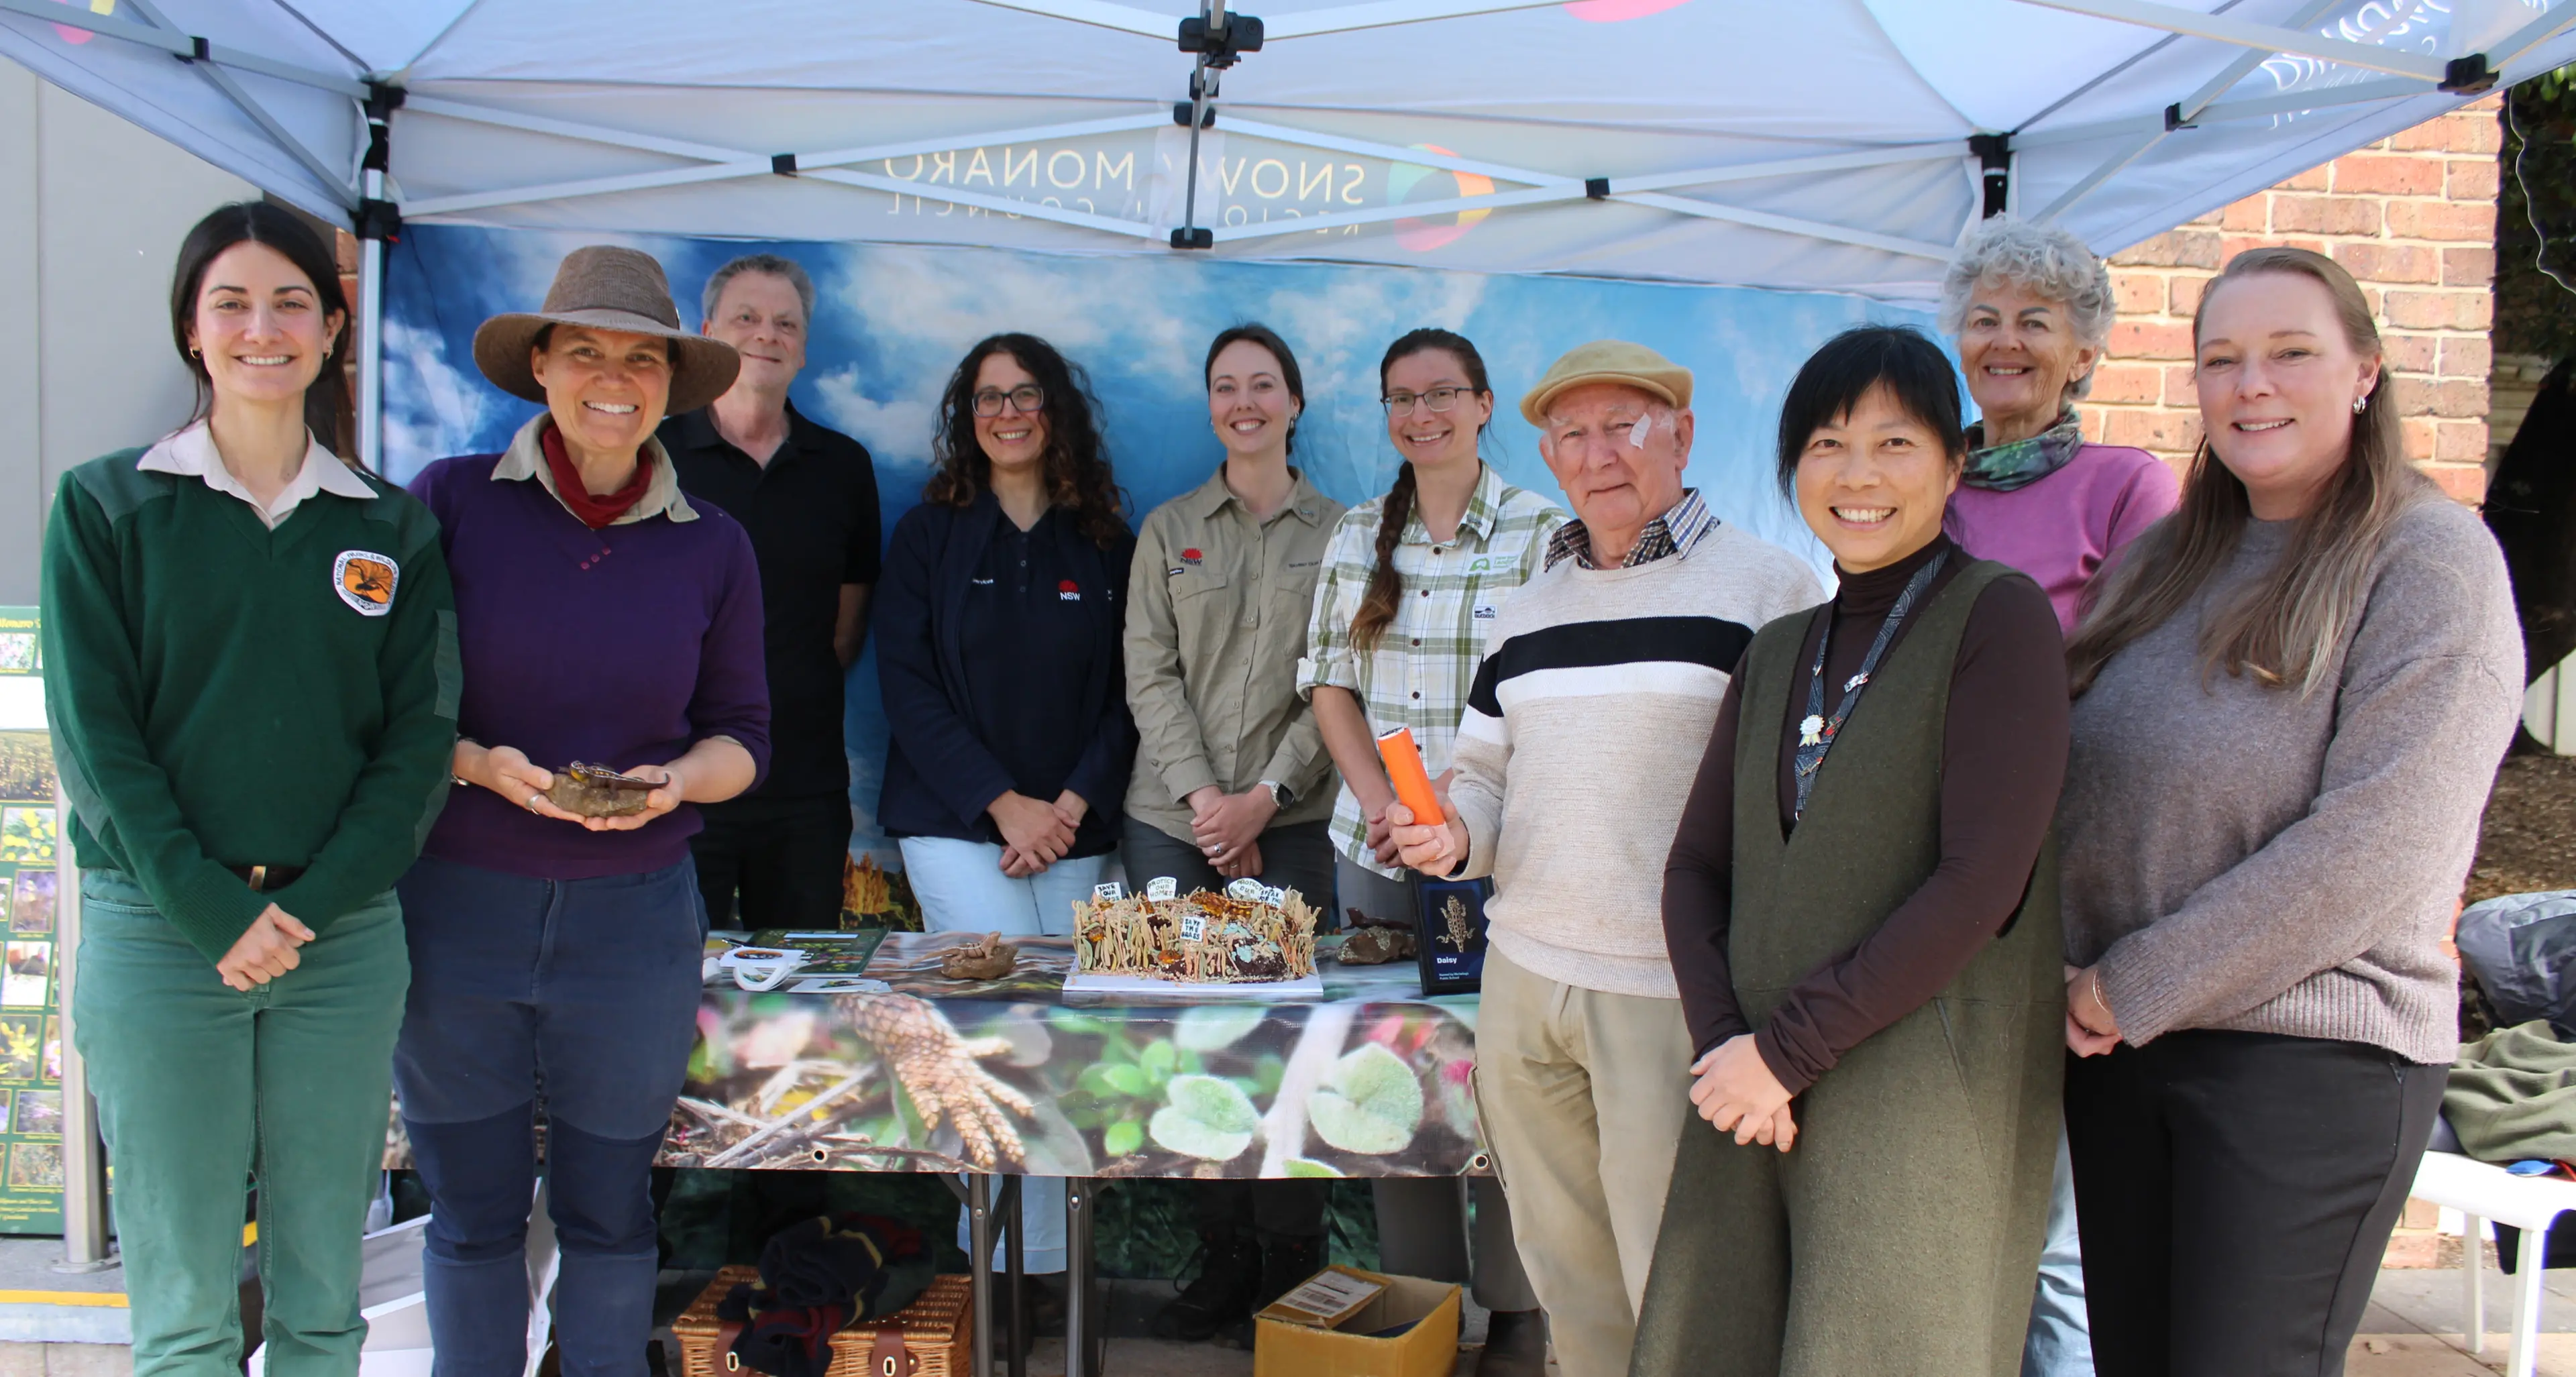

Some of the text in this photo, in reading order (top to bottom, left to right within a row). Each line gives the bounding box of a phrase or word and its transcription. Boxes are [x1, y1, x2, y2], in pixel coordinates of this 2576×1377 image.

[1180, 557, 1202, 566] NSW
[1060, 592, 1080, 601] NSW
[1148, 879, 1174, 889] PROTECT
[1237, 879, 1264, 891] PROTECT
[1150, 889, 1174, 897] HOMES
[1240, 886, 1254, 894] OUR
[1185, 925, 1199, 933] THE
[1181, 932, 1200, 940] GRASS
[1436, 956, 1457, 965] Daisy
